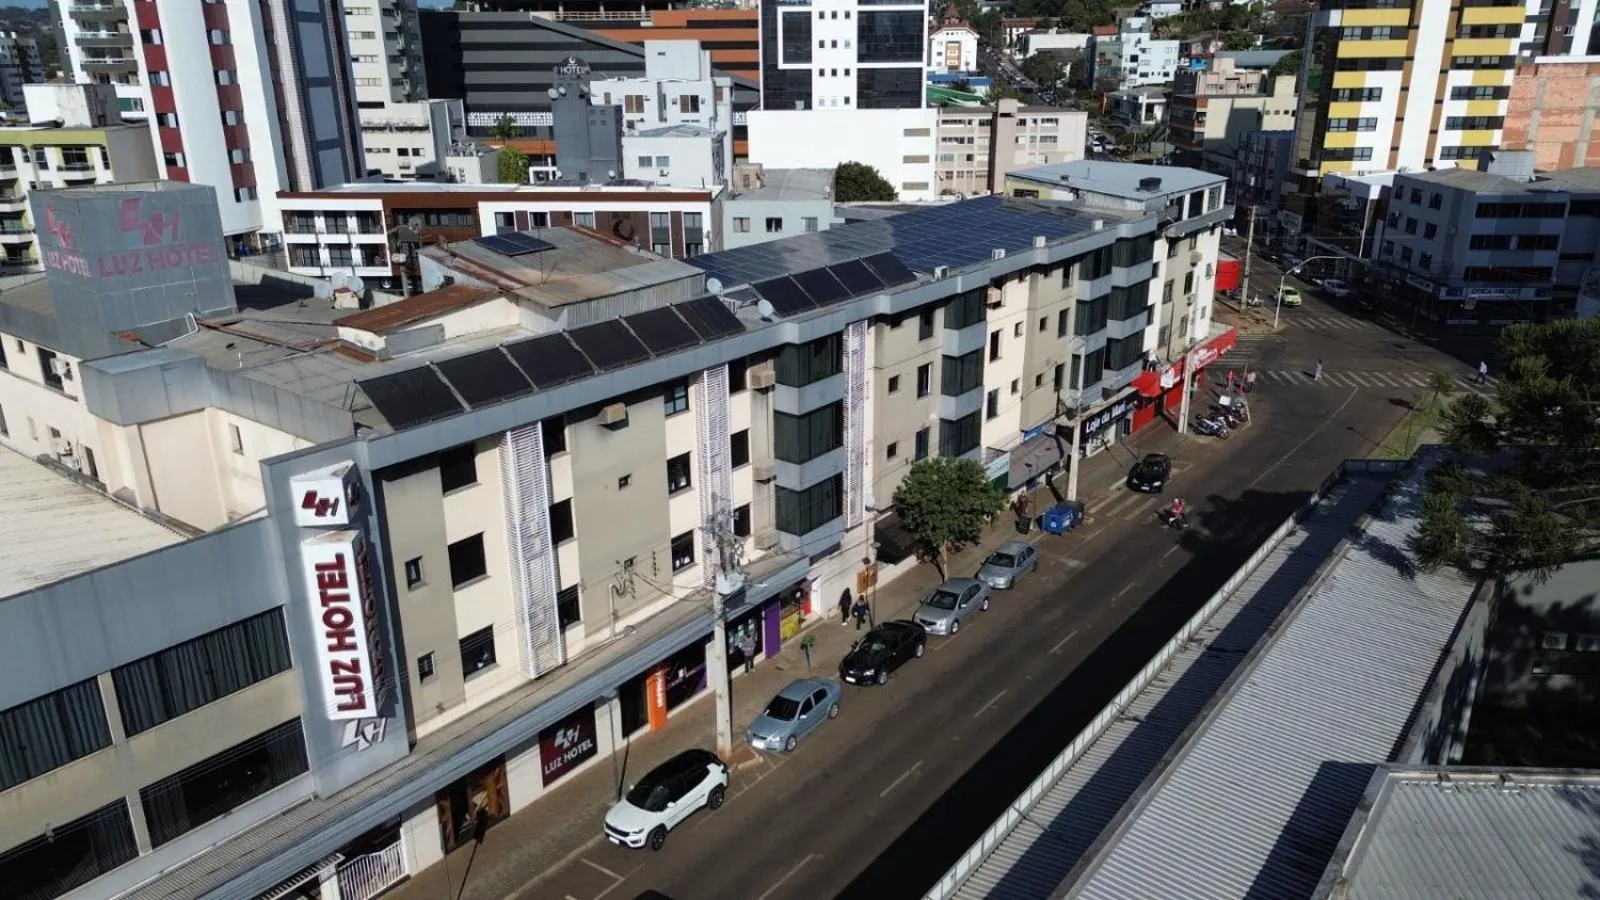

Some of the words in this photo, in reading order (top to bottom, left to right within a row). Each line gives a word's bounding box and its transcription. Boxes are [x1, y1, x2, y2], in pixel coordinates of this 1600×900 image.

[98, 253, 144, 278] LUZ
[149, 242, 220, 272] HOTEL
[314, 552, 358, 653] HOTEL
[329, 657, 367, 712] LUZ
[544, 756, 563, 775] LUZ
[563, 738, 594, 764] HOTEL
